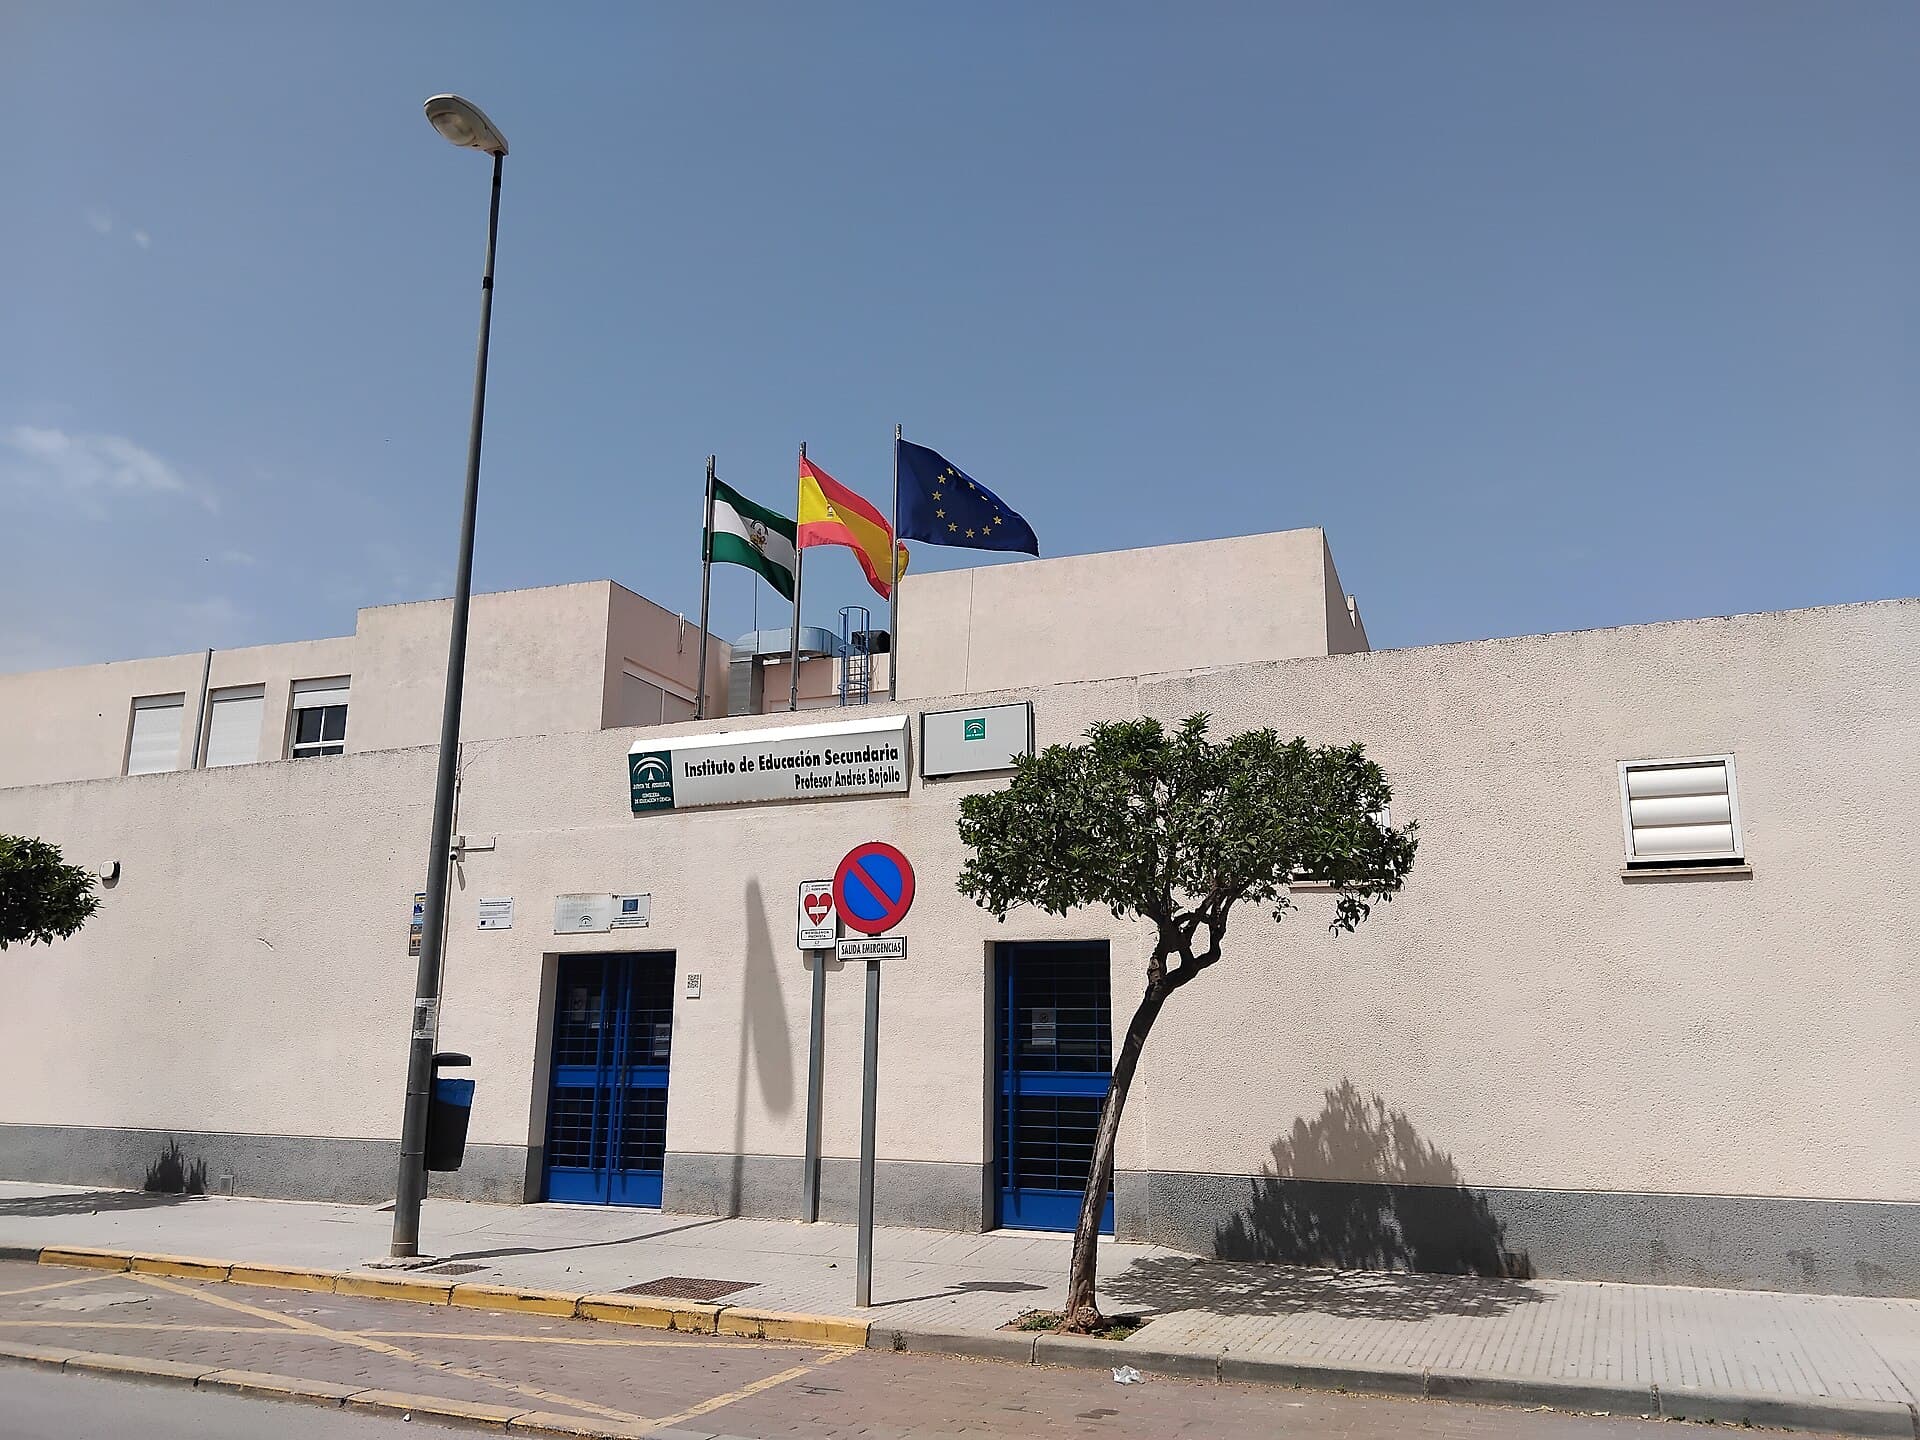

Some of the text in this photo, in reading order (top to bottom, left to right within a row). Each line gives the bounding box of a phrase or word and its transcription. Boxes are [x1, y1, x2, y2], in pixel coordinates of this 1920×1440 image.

[684, 743, 899, 778] Instituto de Educación Secundaria
[794, 766, 901, 790] Profesor Andrés Bojollo
[862, 942, 902, 954] EMERGENCIAS
